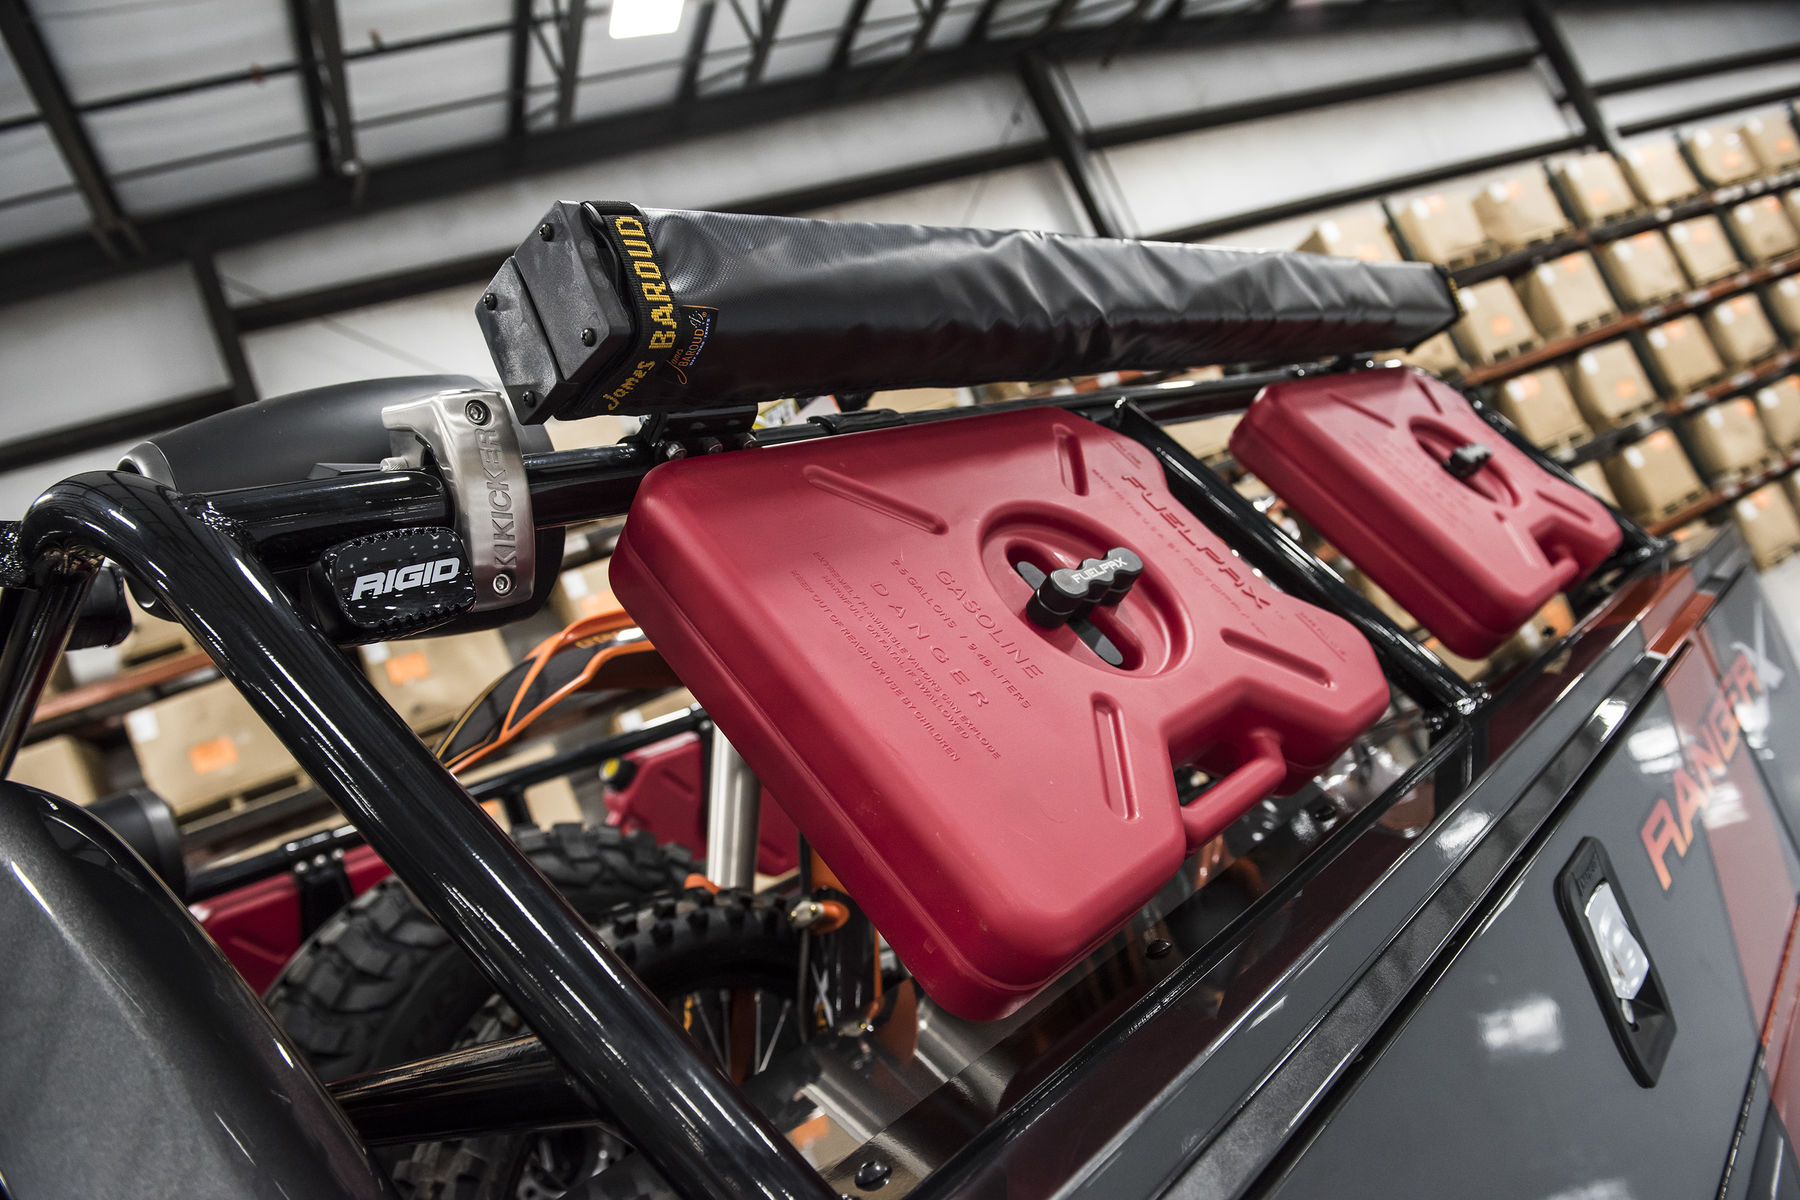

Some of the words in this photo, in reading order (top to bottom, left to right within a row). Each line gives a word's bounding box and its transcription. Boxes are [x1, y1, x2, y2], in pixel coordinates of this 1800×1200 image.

[615, 216, 677, 349] BAROUD
[678, 328, 704, 367] BAROUD
[351, 557, 460, 601] RIGID
[1071, 557, 1128, 583] FUELPAX
[1121, 475, 1271, 610] FUELPAX
[812, 594, 833, 613] OUT
[830, 614, 845, 627] OF
[841, 628, 873, 661] REACH
[871, 661, 886, 676] OR
[884, 676, 905, 697] USE
[902, 697, 917, 710] BY
[914, 711, 961, 762] CHILDREN
[870, 582, 990, 708] DANGER
[907, 576, 957, 629] GALLONS
[991, 667, 1032, 709] LITERS
[936, 569, 1044, 679] GASOLINE
[879, 639, 905, 668] FATAL
[914, 679, 970, 739] SWALLOWED
[907, 653, 942, 693] VAPORS
[940, 693, 961, 714] CAN
[960, 715, 1001, 760] EXPLODE
